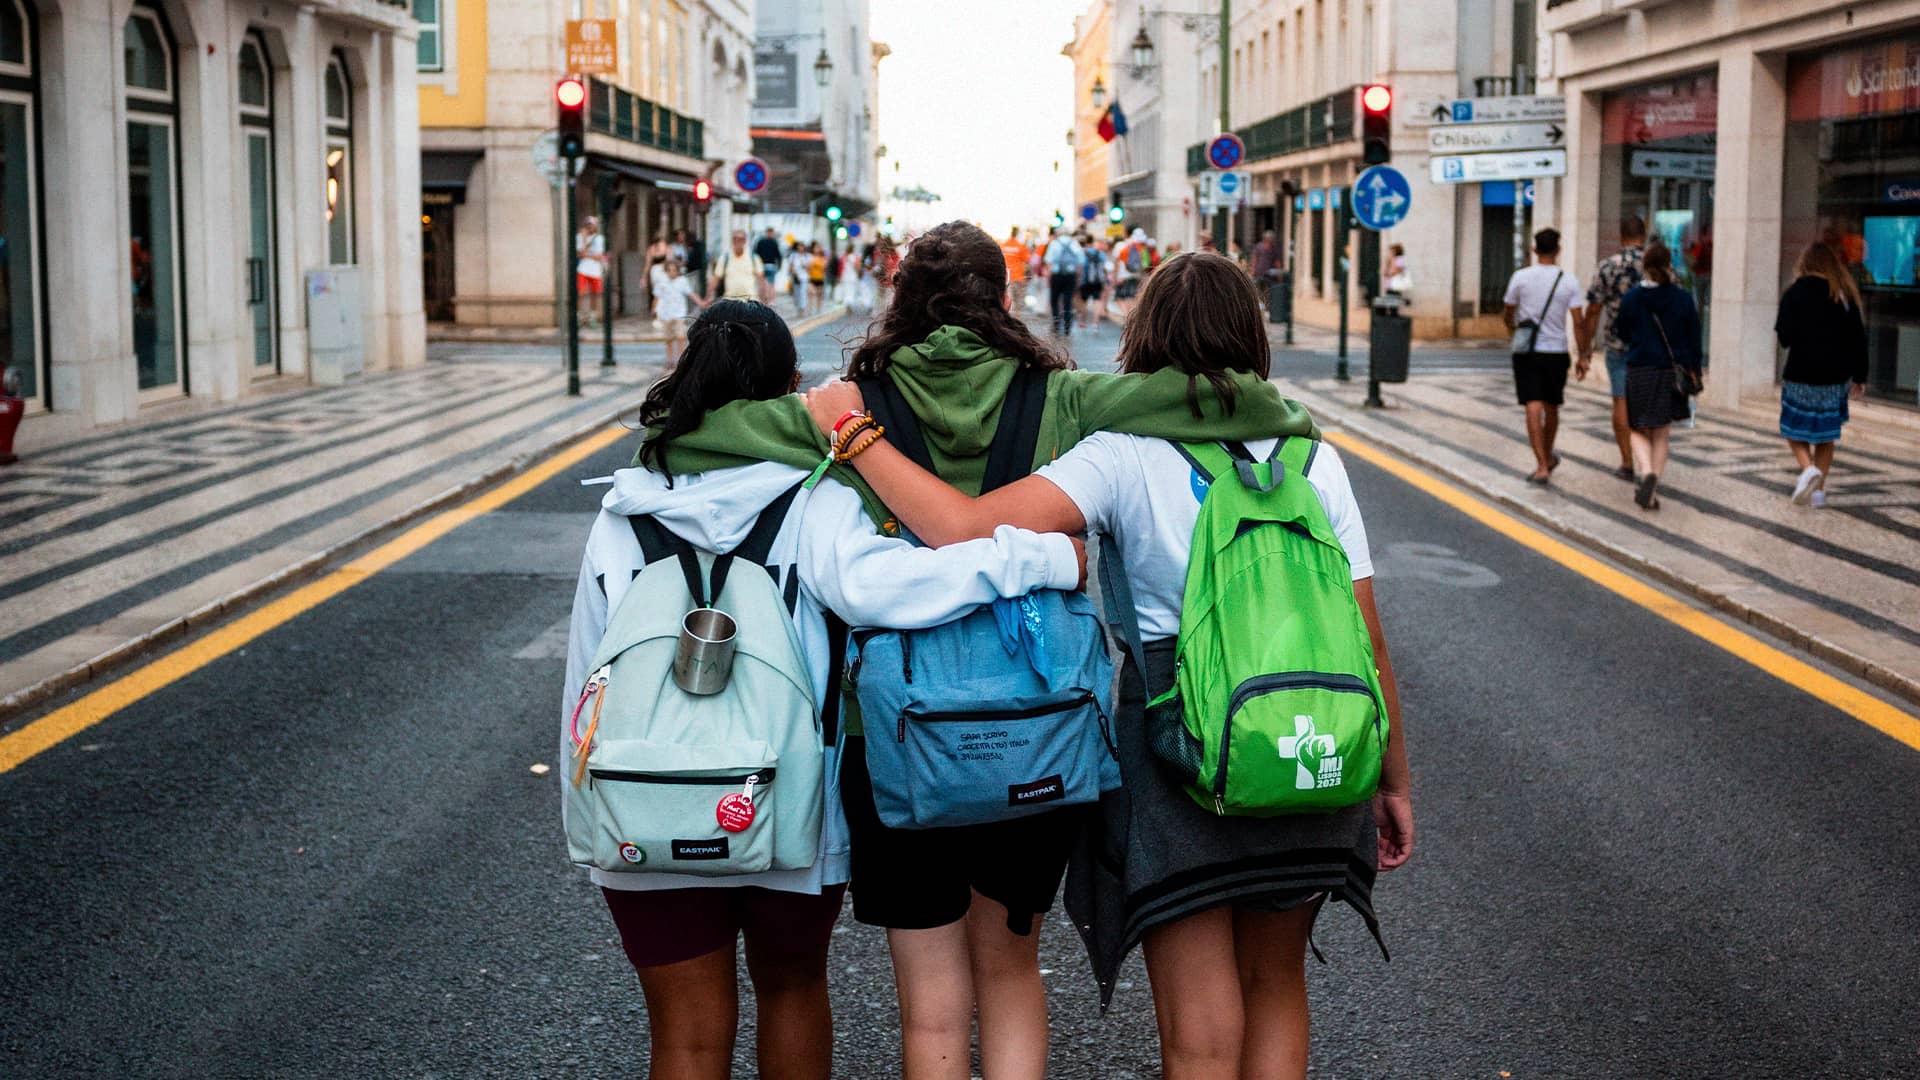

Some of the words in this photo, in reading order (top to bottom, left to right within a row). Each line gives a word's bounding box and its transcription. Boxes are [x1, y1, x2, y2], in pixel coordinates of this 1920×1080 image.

[1318, 756, 1343, 773] JMJ
[1317, 771, 1342, 780] LISBOA
[1316, 777, 1342, 789] 2023
[1017, 785, 1057, 799] EASTPAK
[679, 846, 721, 854] EASTPAK
